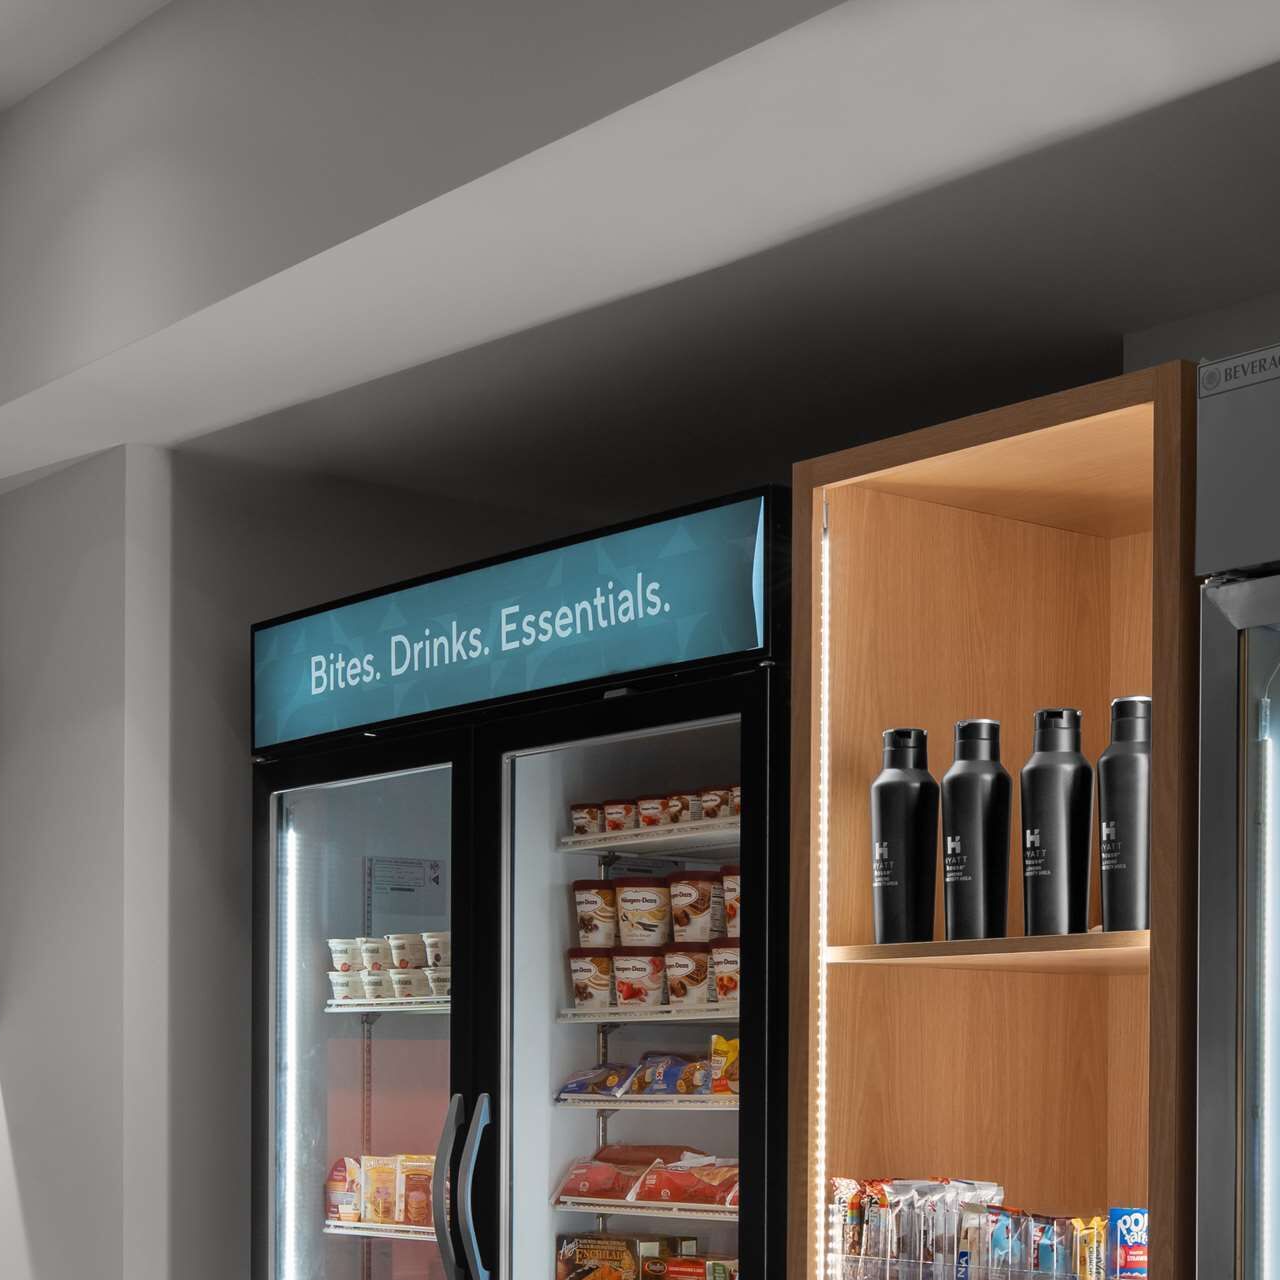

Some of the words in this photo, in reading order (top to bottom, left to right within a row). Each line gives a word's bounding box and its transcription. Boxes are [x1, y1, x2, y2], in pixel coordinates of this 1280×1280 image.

[311, 654, 381, 696] Bites.
[391, 621, 489, 677] Drinks.
[501, 572, 671, 652] Essentials.
